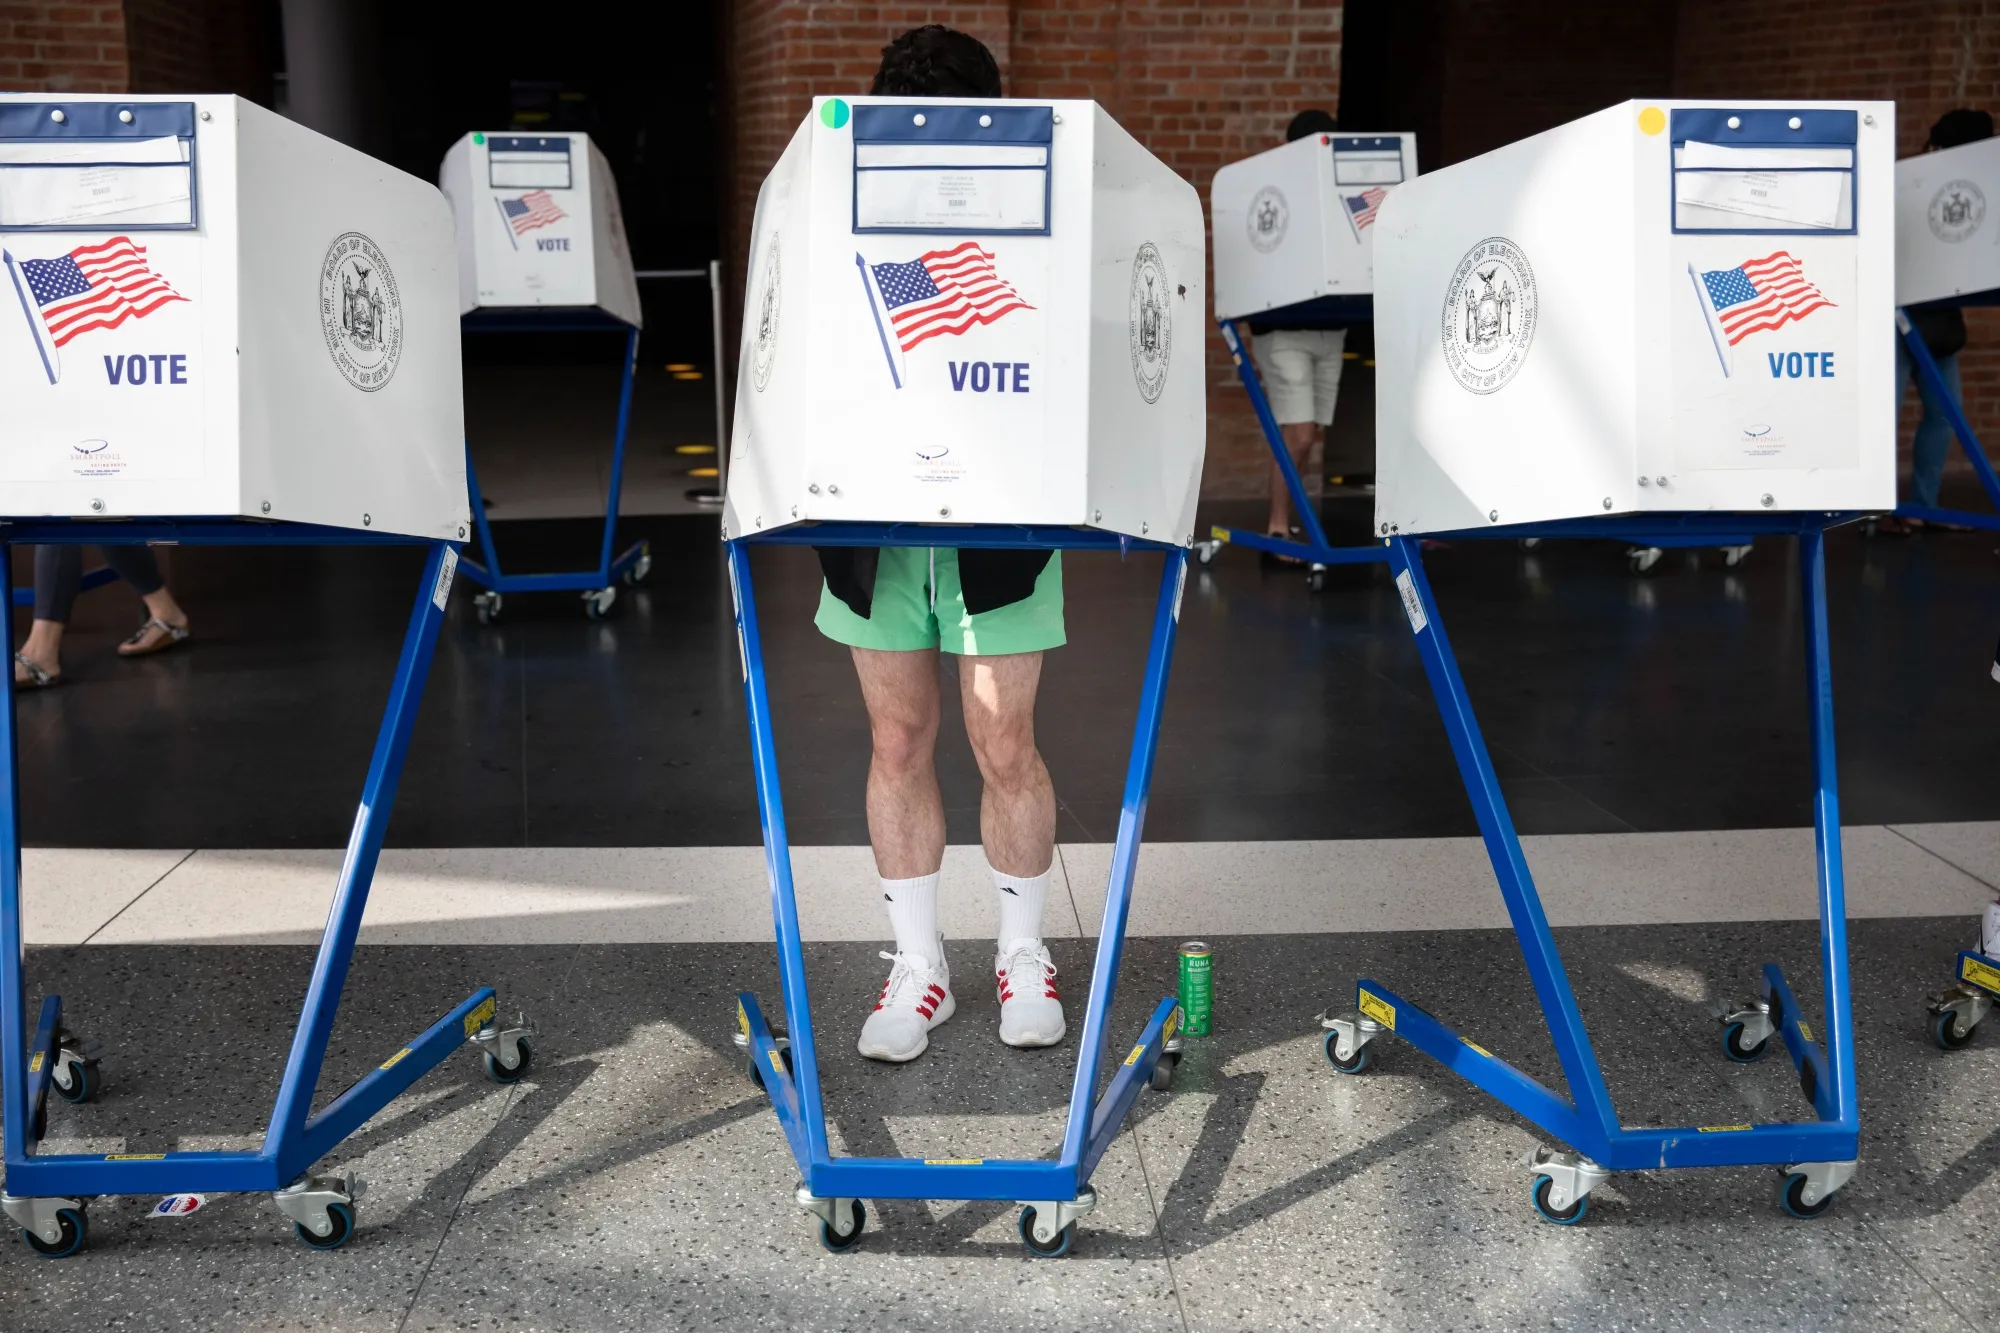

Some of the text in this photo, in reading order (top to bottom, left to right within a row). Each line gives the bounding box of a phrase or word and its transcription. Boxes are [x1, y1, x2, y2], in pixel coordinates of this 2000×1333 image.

[536, 238, 571, 252] VOTE
[325, 239, 398, 309] BOARD OF ELECTIONS
[1448, 244, 1531, 307] BOARD OF ELECTIONS
[1448, 342, 1462, 370] THE
[1461, 369, 1482, 387] CITY
[1483, 373, 1497, 387] OF
[1499, 351, 1519, 378] NEW
[1517, 307, 1533, 349] YORK
[104, 354, 187, 385] VOTE
[338, 352, 358, 379] CITY
[359, 371, 371, 384] OF
[372, 362, 389, 384] NEW
[948, 361, 1030, 393] VOTE
[1768, 352, 1835, 379] VOTE
